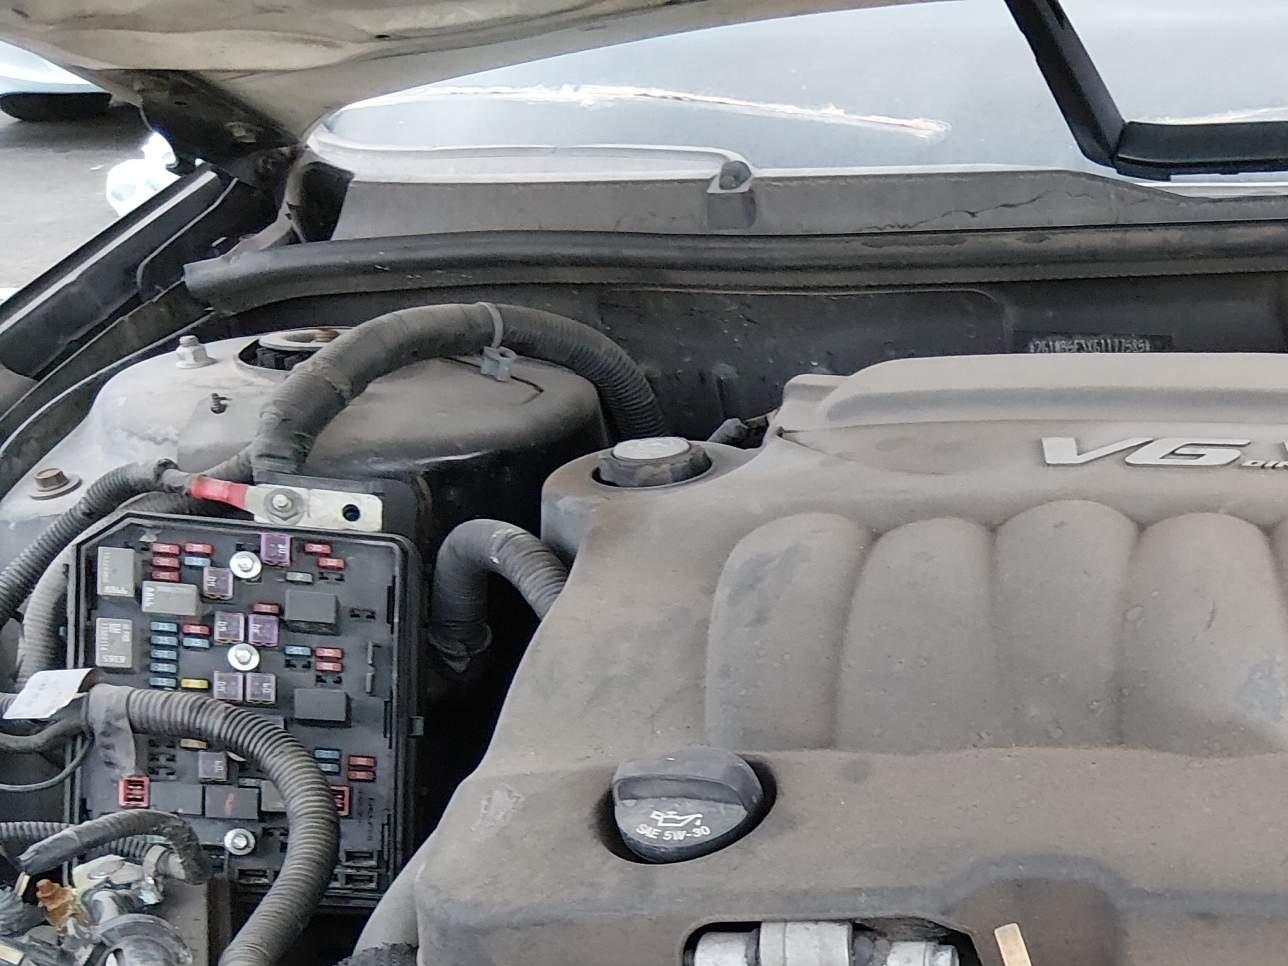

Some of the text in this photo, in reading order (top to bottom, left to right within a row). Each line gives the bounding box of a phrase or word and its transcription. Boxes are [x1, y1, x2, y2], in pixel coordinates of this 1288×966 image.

[1040, 437, 1252, 466] V6
[635, 823, 711, 840] SAE 5W-30
